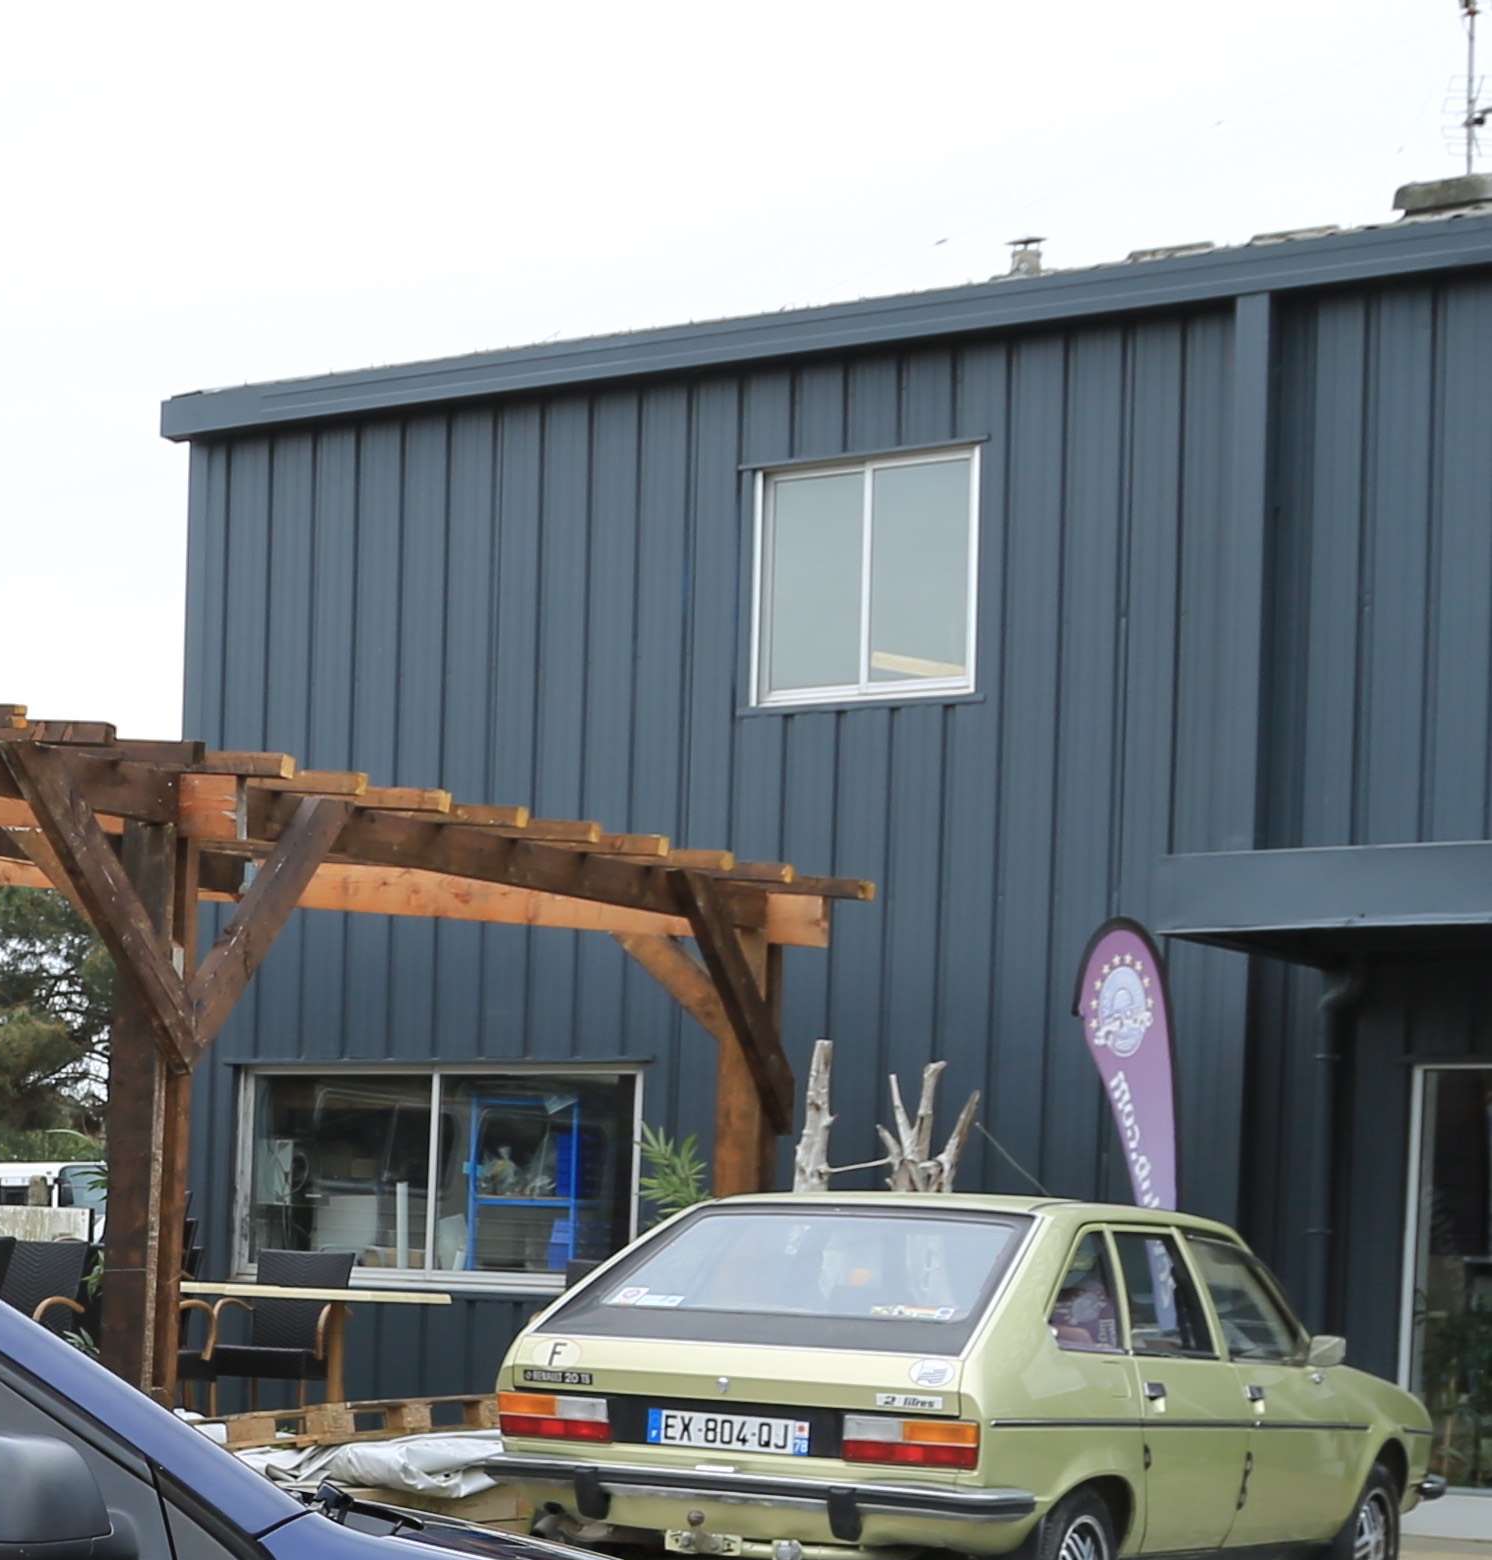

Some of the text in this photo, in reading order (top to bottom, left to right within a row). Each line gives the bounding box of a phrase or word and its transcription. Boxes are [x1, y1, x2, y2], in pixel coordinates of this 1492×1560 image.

[547, 1341, 569, 1367] F
[564, 1372, 580, 1384] 20
[883, 1395, 936, 1408] 2 litres
[663, 1413, 790, 1450] EX-804-QJ
[793, 1439, 809, 1454] 78
